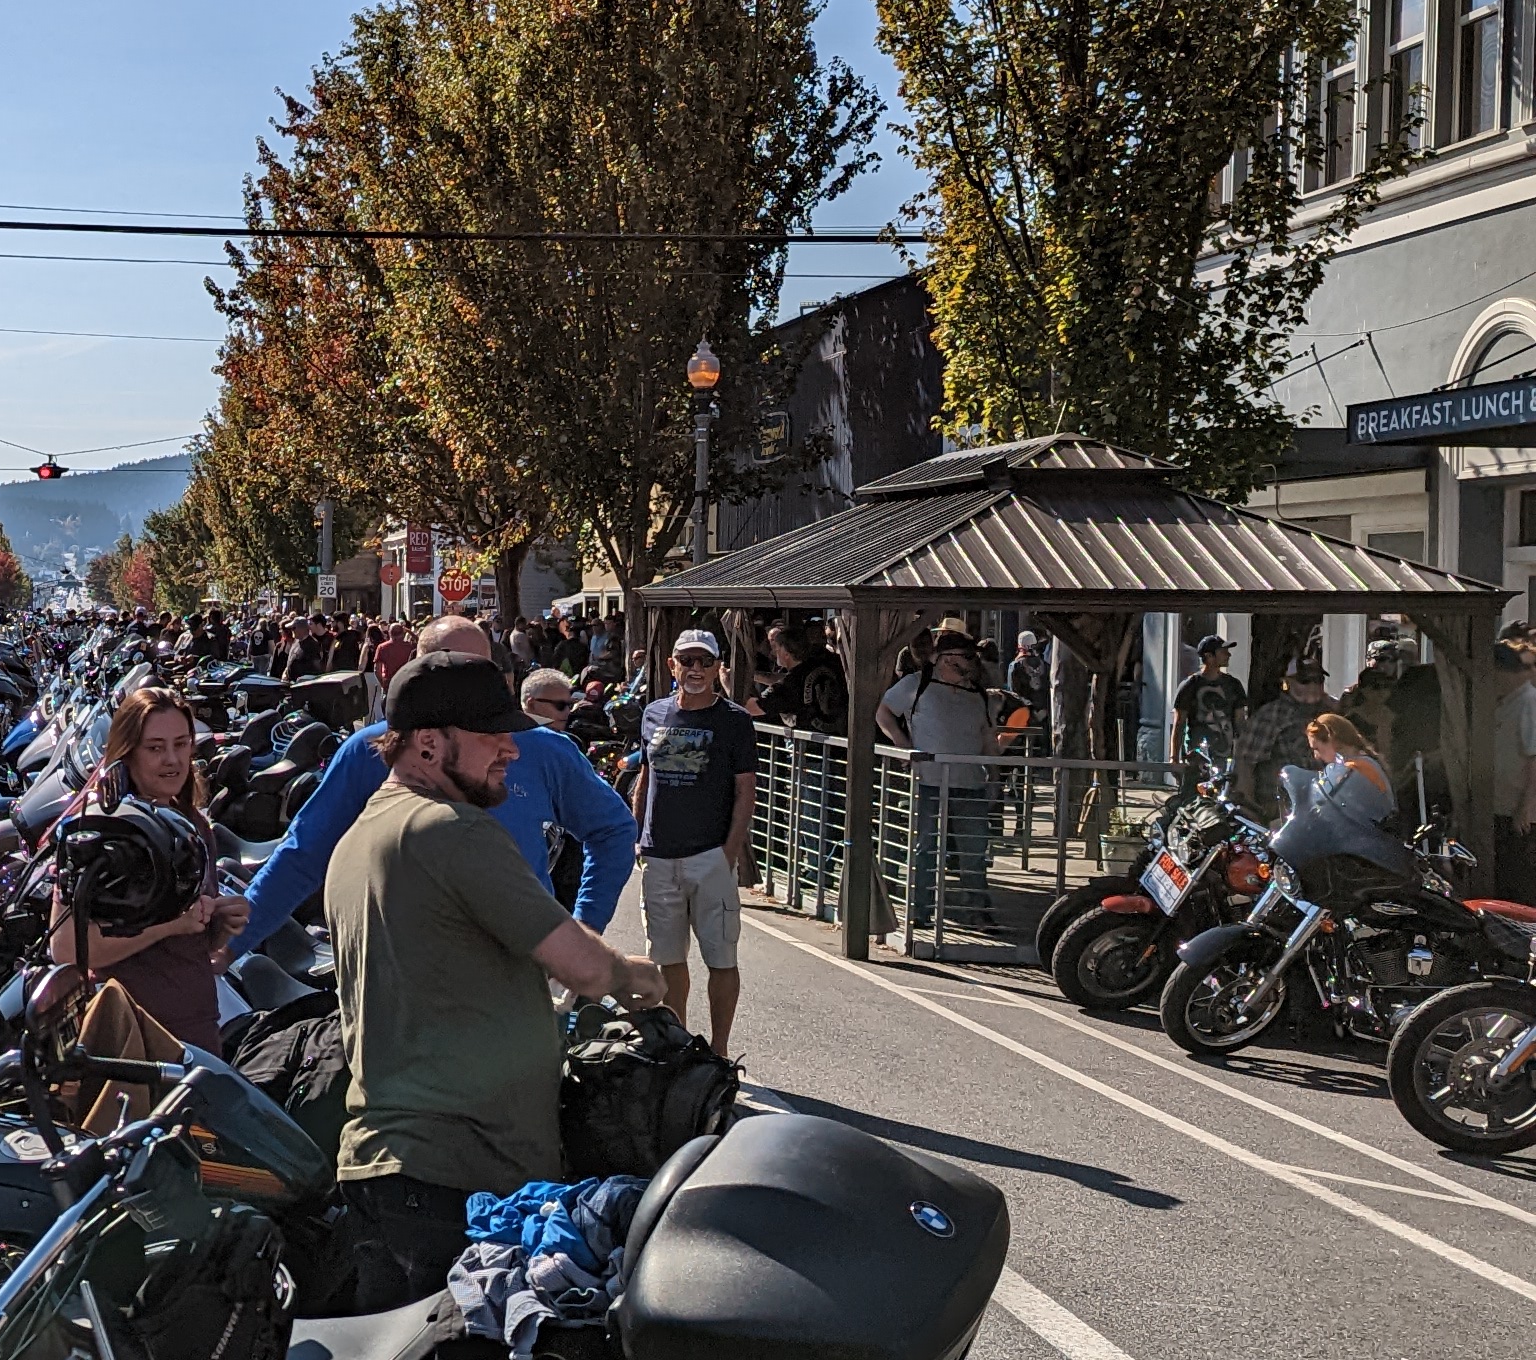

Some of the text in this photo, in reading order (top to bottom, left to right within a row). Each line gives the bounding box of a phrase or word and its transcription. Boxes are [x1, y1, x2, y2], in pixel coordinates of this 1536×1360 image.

[1357, 400, 1456, 436] BREAKFAST,
[1461, 390, 1524, 421] LUNCH
[409, 532, 429, 545] RED
[319, 586, 335, 596] 20
[439, 577, 470, 591] STOP
[1158, 854, 1175, 874] FOR
[1170, 867, 1189, 890] SALE
